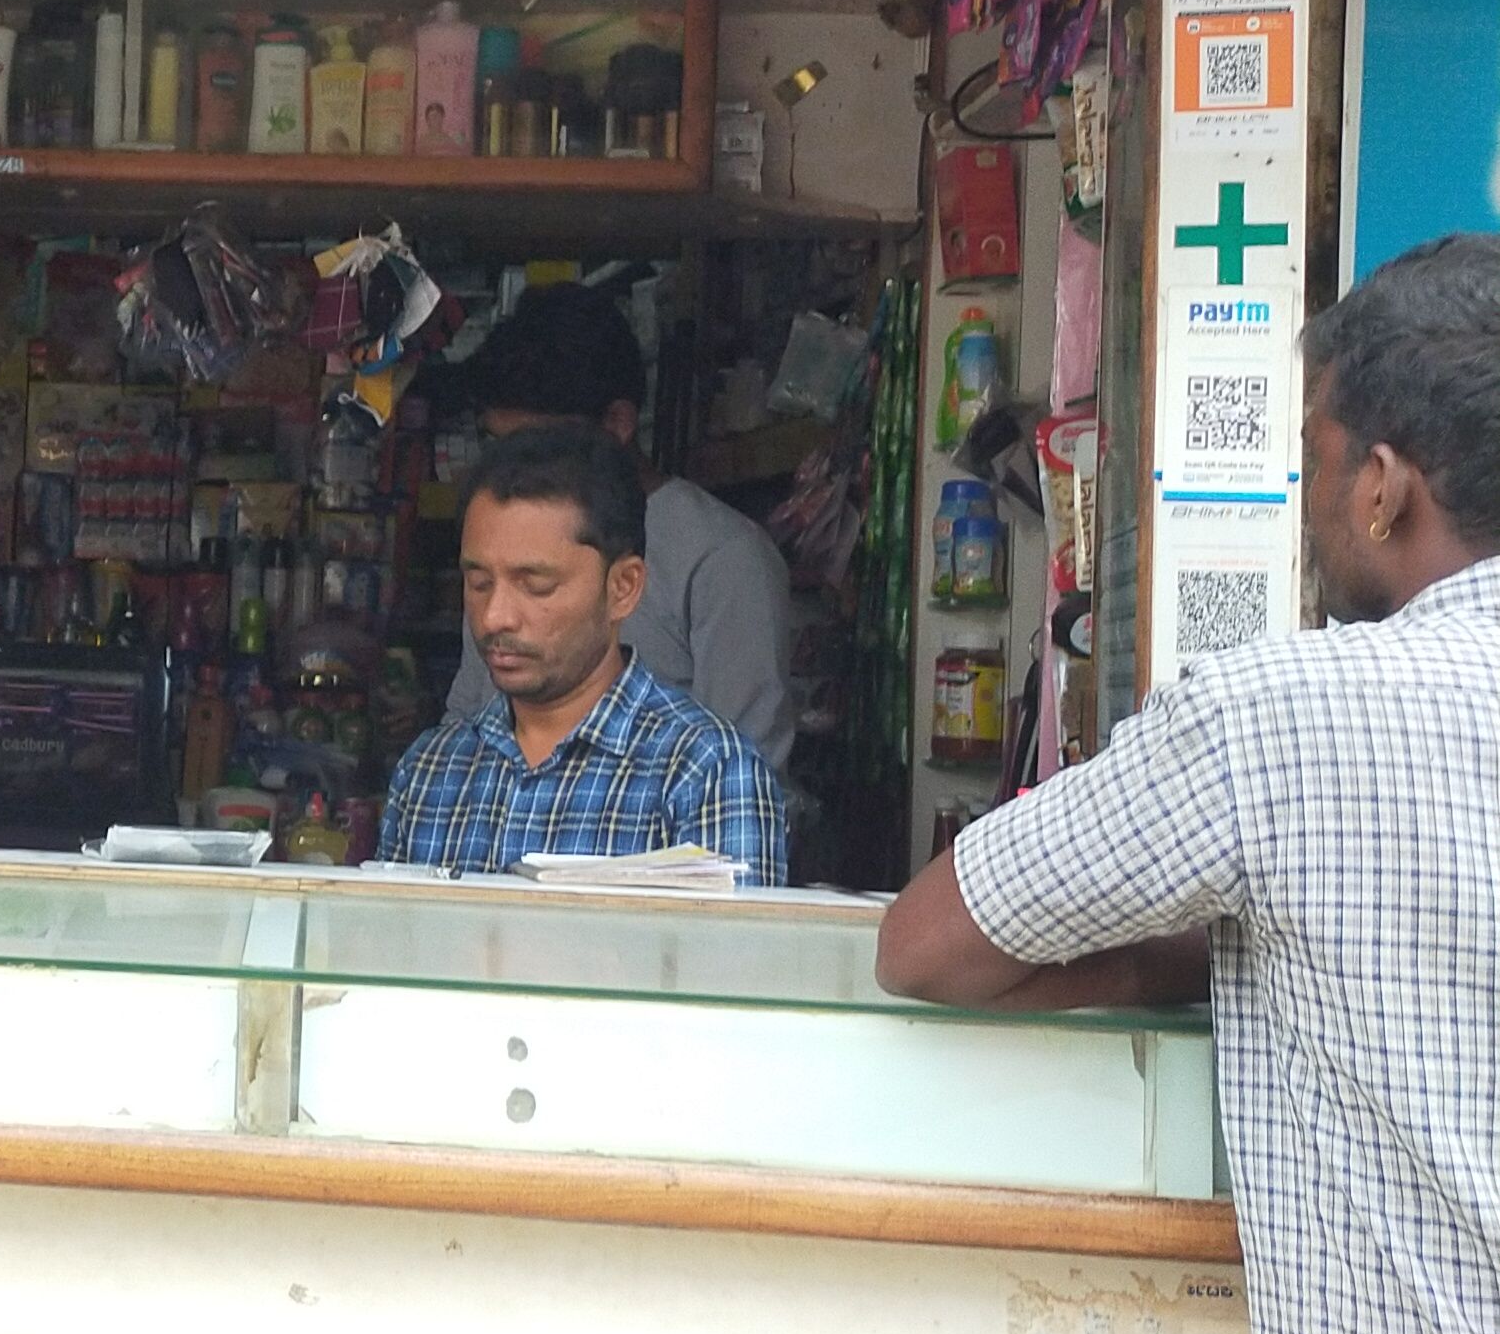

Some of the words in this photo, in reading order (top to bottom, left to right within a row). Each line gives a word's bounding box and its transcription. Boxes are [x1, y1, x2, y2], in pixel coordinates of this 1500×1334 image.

[1188, 298, 1270, 323] paytm
[1187, 325, 1240, 337] Accepted
[1243, 326, 1271, 336] Here
[1171, 505, 1226, 519] BHIM
[1238, 506, 1274, 520] UPI
